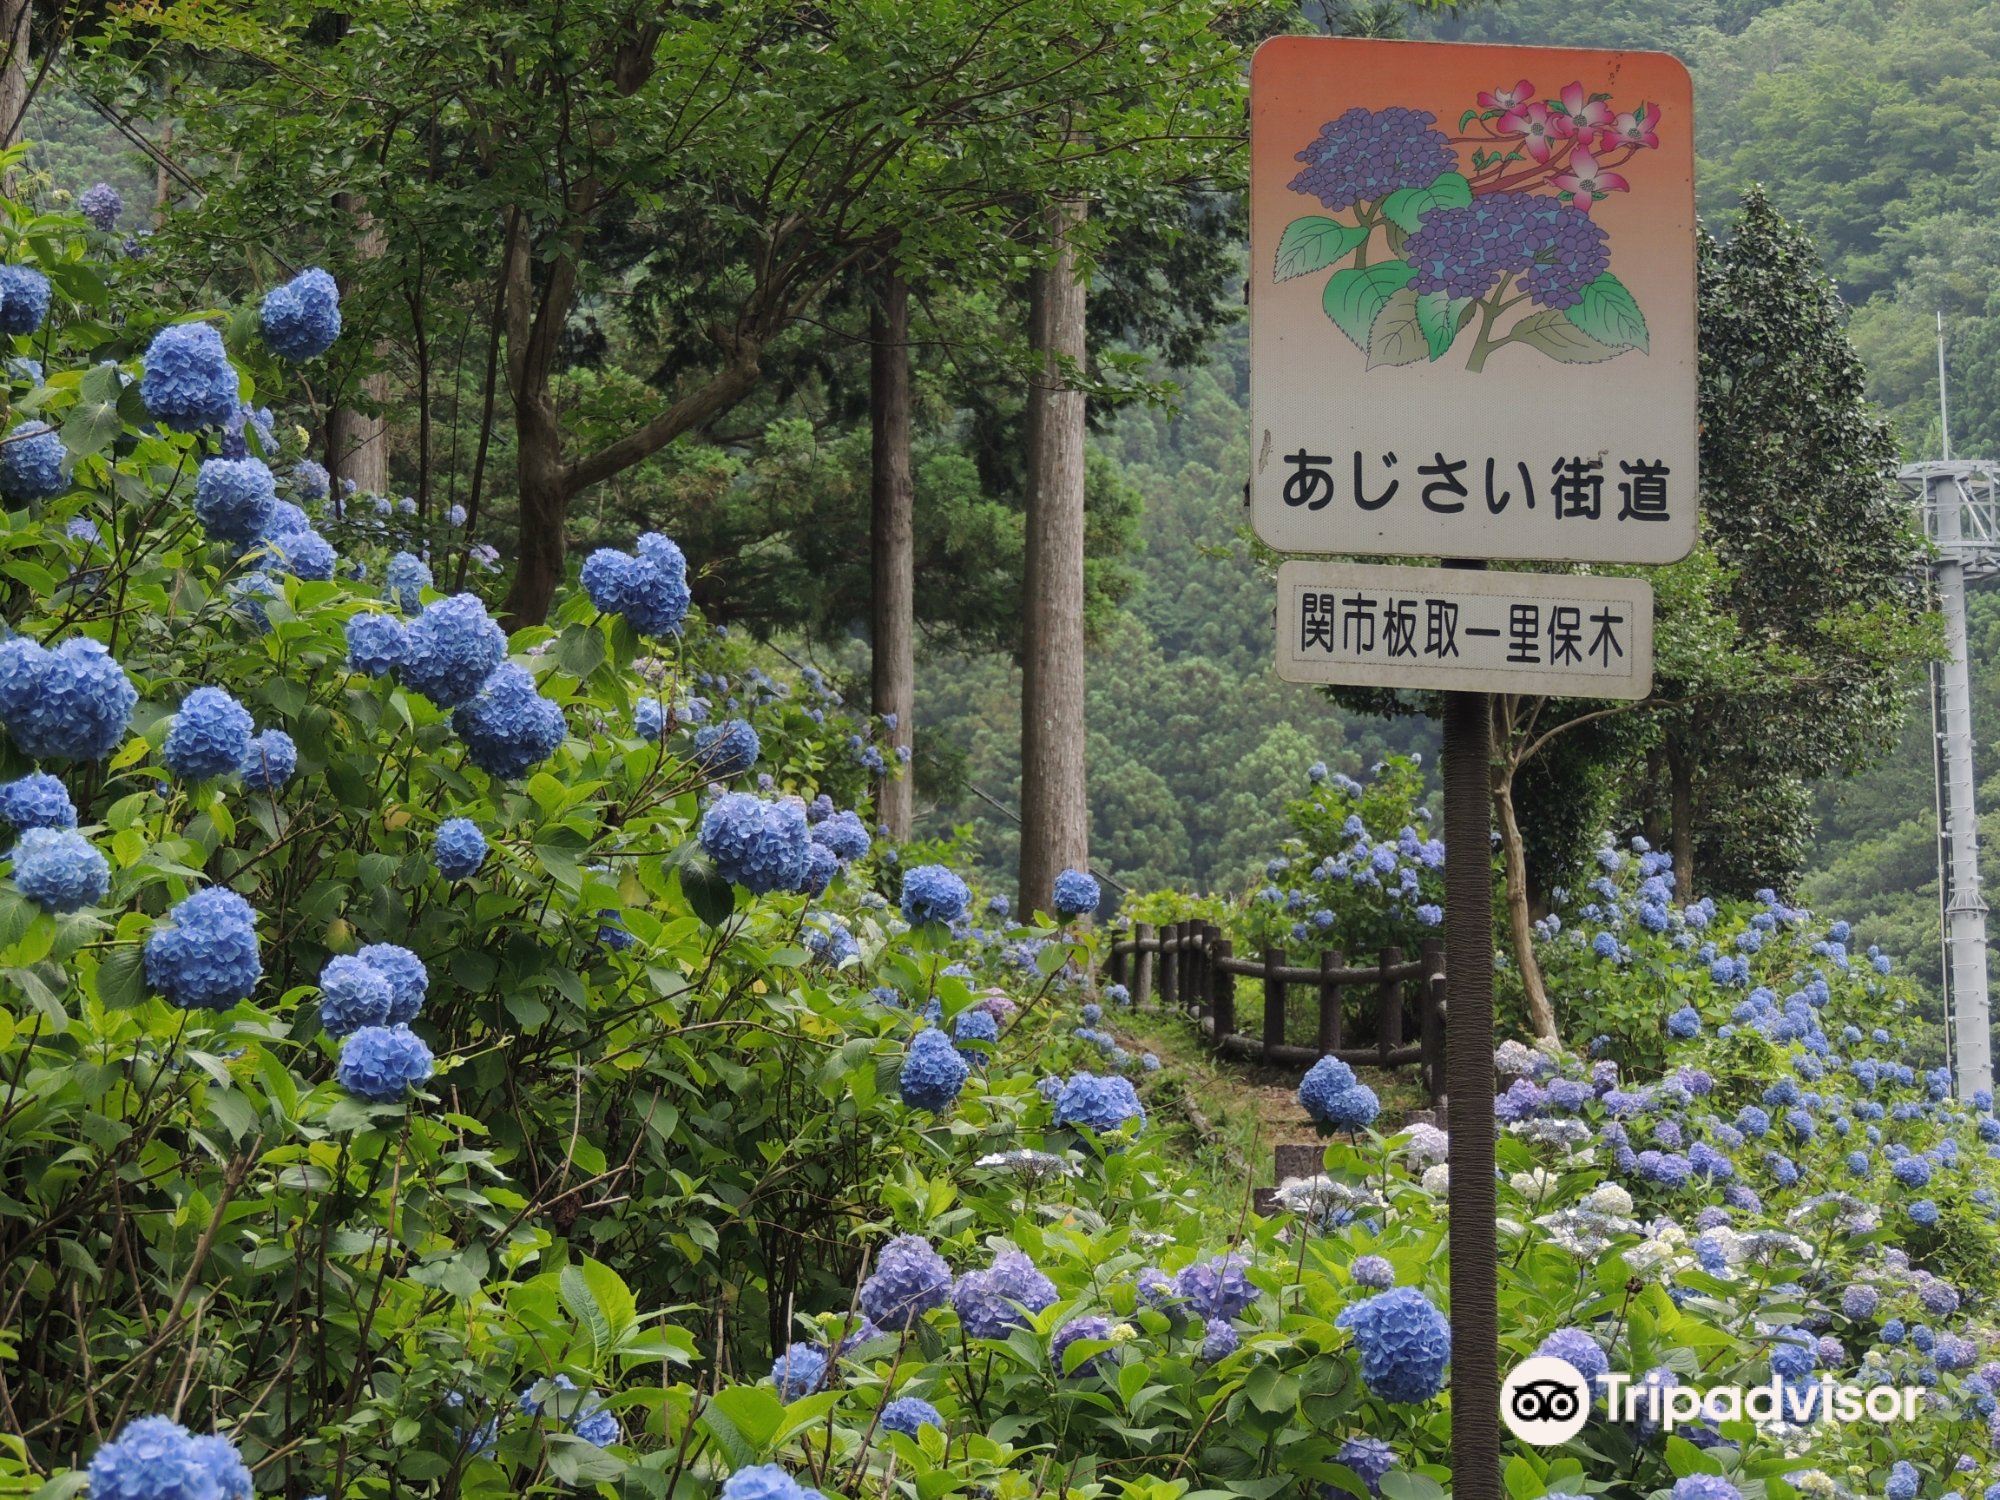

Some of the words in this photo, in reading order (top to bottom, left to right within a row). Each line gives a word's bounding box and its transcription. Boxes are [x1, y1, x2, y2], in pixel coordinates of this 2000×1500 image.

[1283, 448, 1670, 522] あじさい街道
[1301, 592, 1624, 668] 関市板取一里保木
